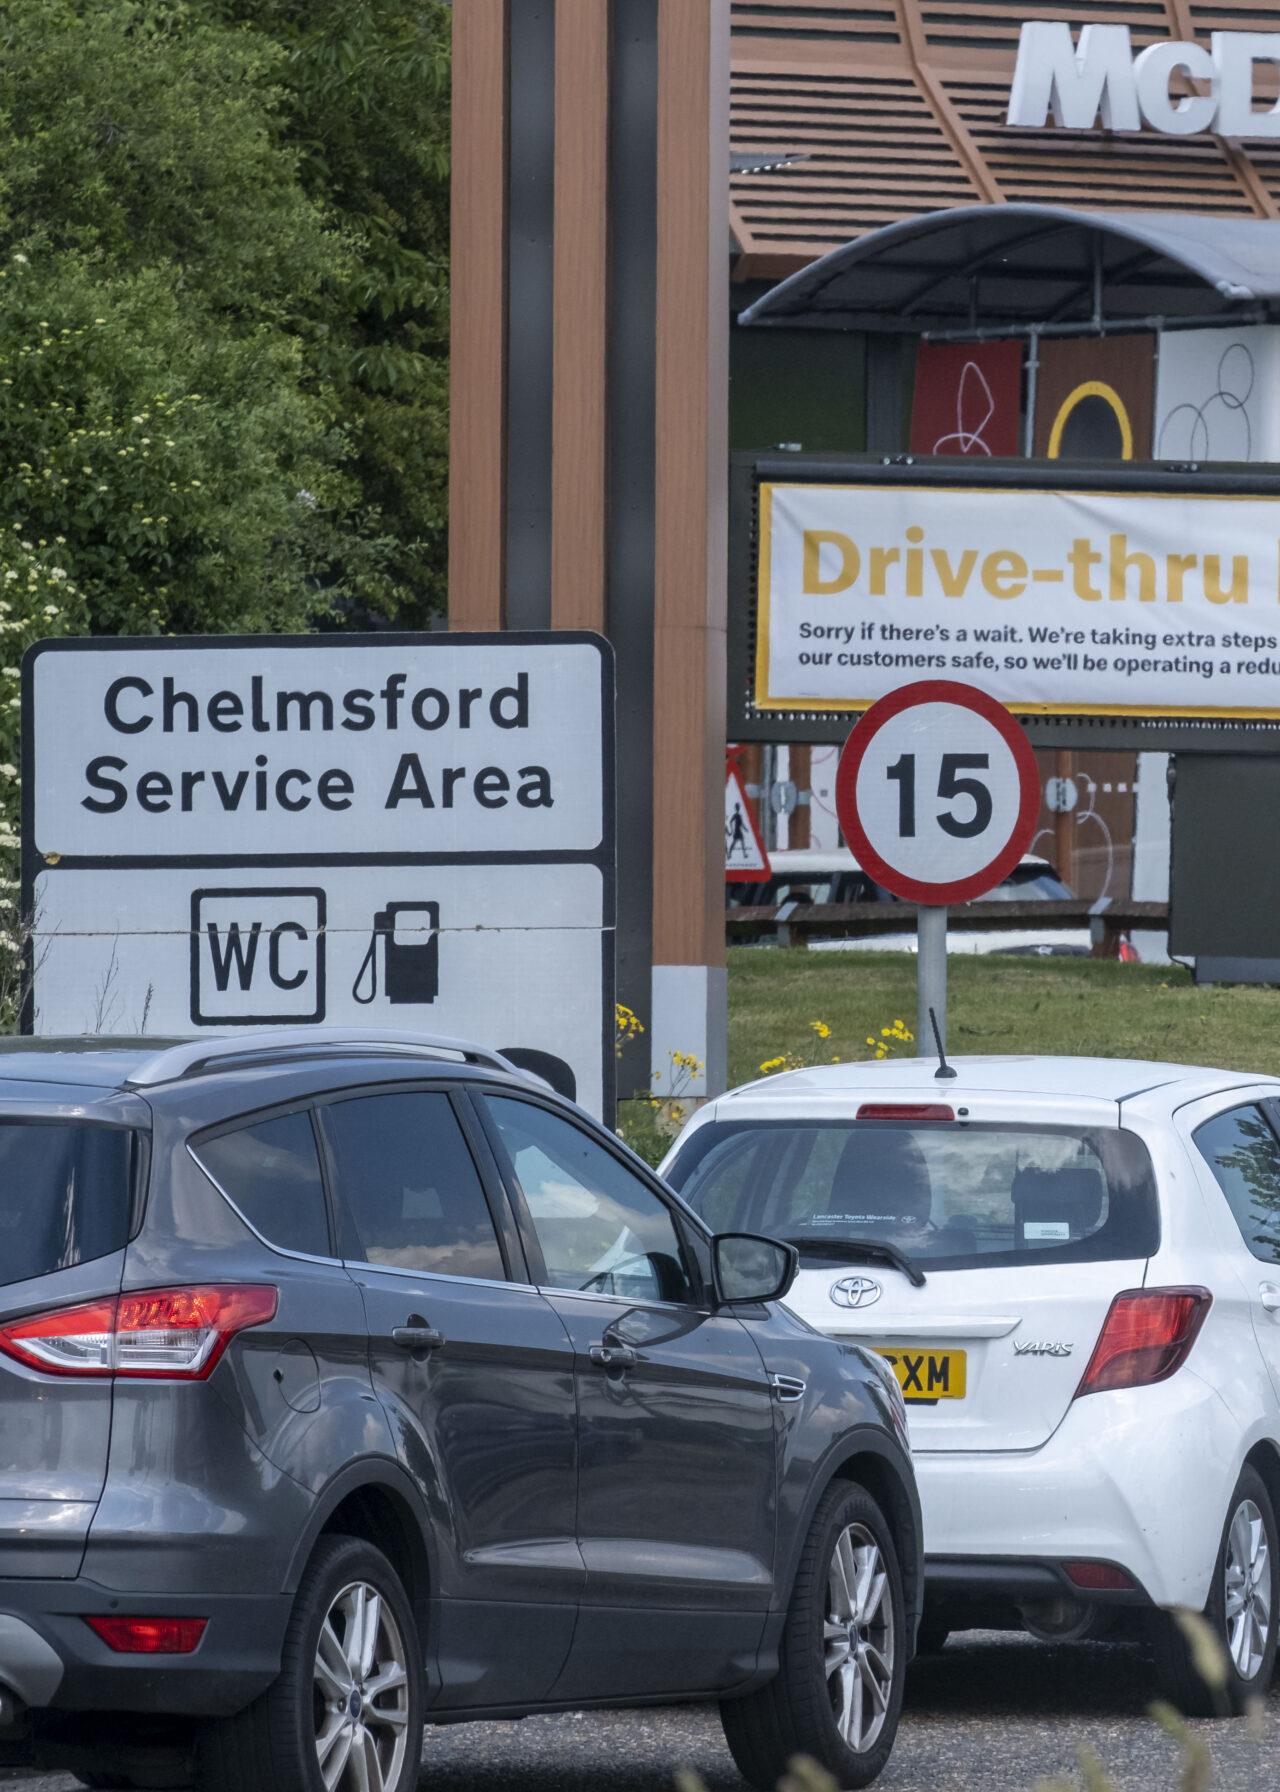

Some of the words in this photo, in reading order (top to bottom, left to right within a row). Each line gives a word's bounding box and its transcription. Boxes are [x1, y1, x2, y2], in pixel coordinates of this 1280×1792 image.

[804, 525, 1247, 603] Drive-thru
[799, 653, 832, 665] our
[837, 652, 946, 667] customers
[952, 652, 999, 671] safe,
[1004, 657, 1027, 669] so
[1033, 654, 1078, 670] we'll
[1083, 654, 1107, 671] be
[1113, 656, 1213, 677] operating
[1220, 662, 1230, 674] a
[800, 623, 854, 644] Sorry
[861, 622, 874, 640] if
[880, 624, 949, 641] there's
[956, 629, 967, 642] a
[974, 626, 1022, 643] wait.
[1028, 627, 1085, 644] We're
[1091, 628, 1156, 650] taking
[1163, 632, 1215, 647] extra
[1222, 632, 1277, 652] steps
[104, 672, 528, 734] Chelmsford
[81, 755, 354, 813] Service
[385, 753, 554, 809] Area
[887, 754, 992, 838] 15
[208, 922, 308, 991] WC
[889, 1355, 950, 1392] XM
